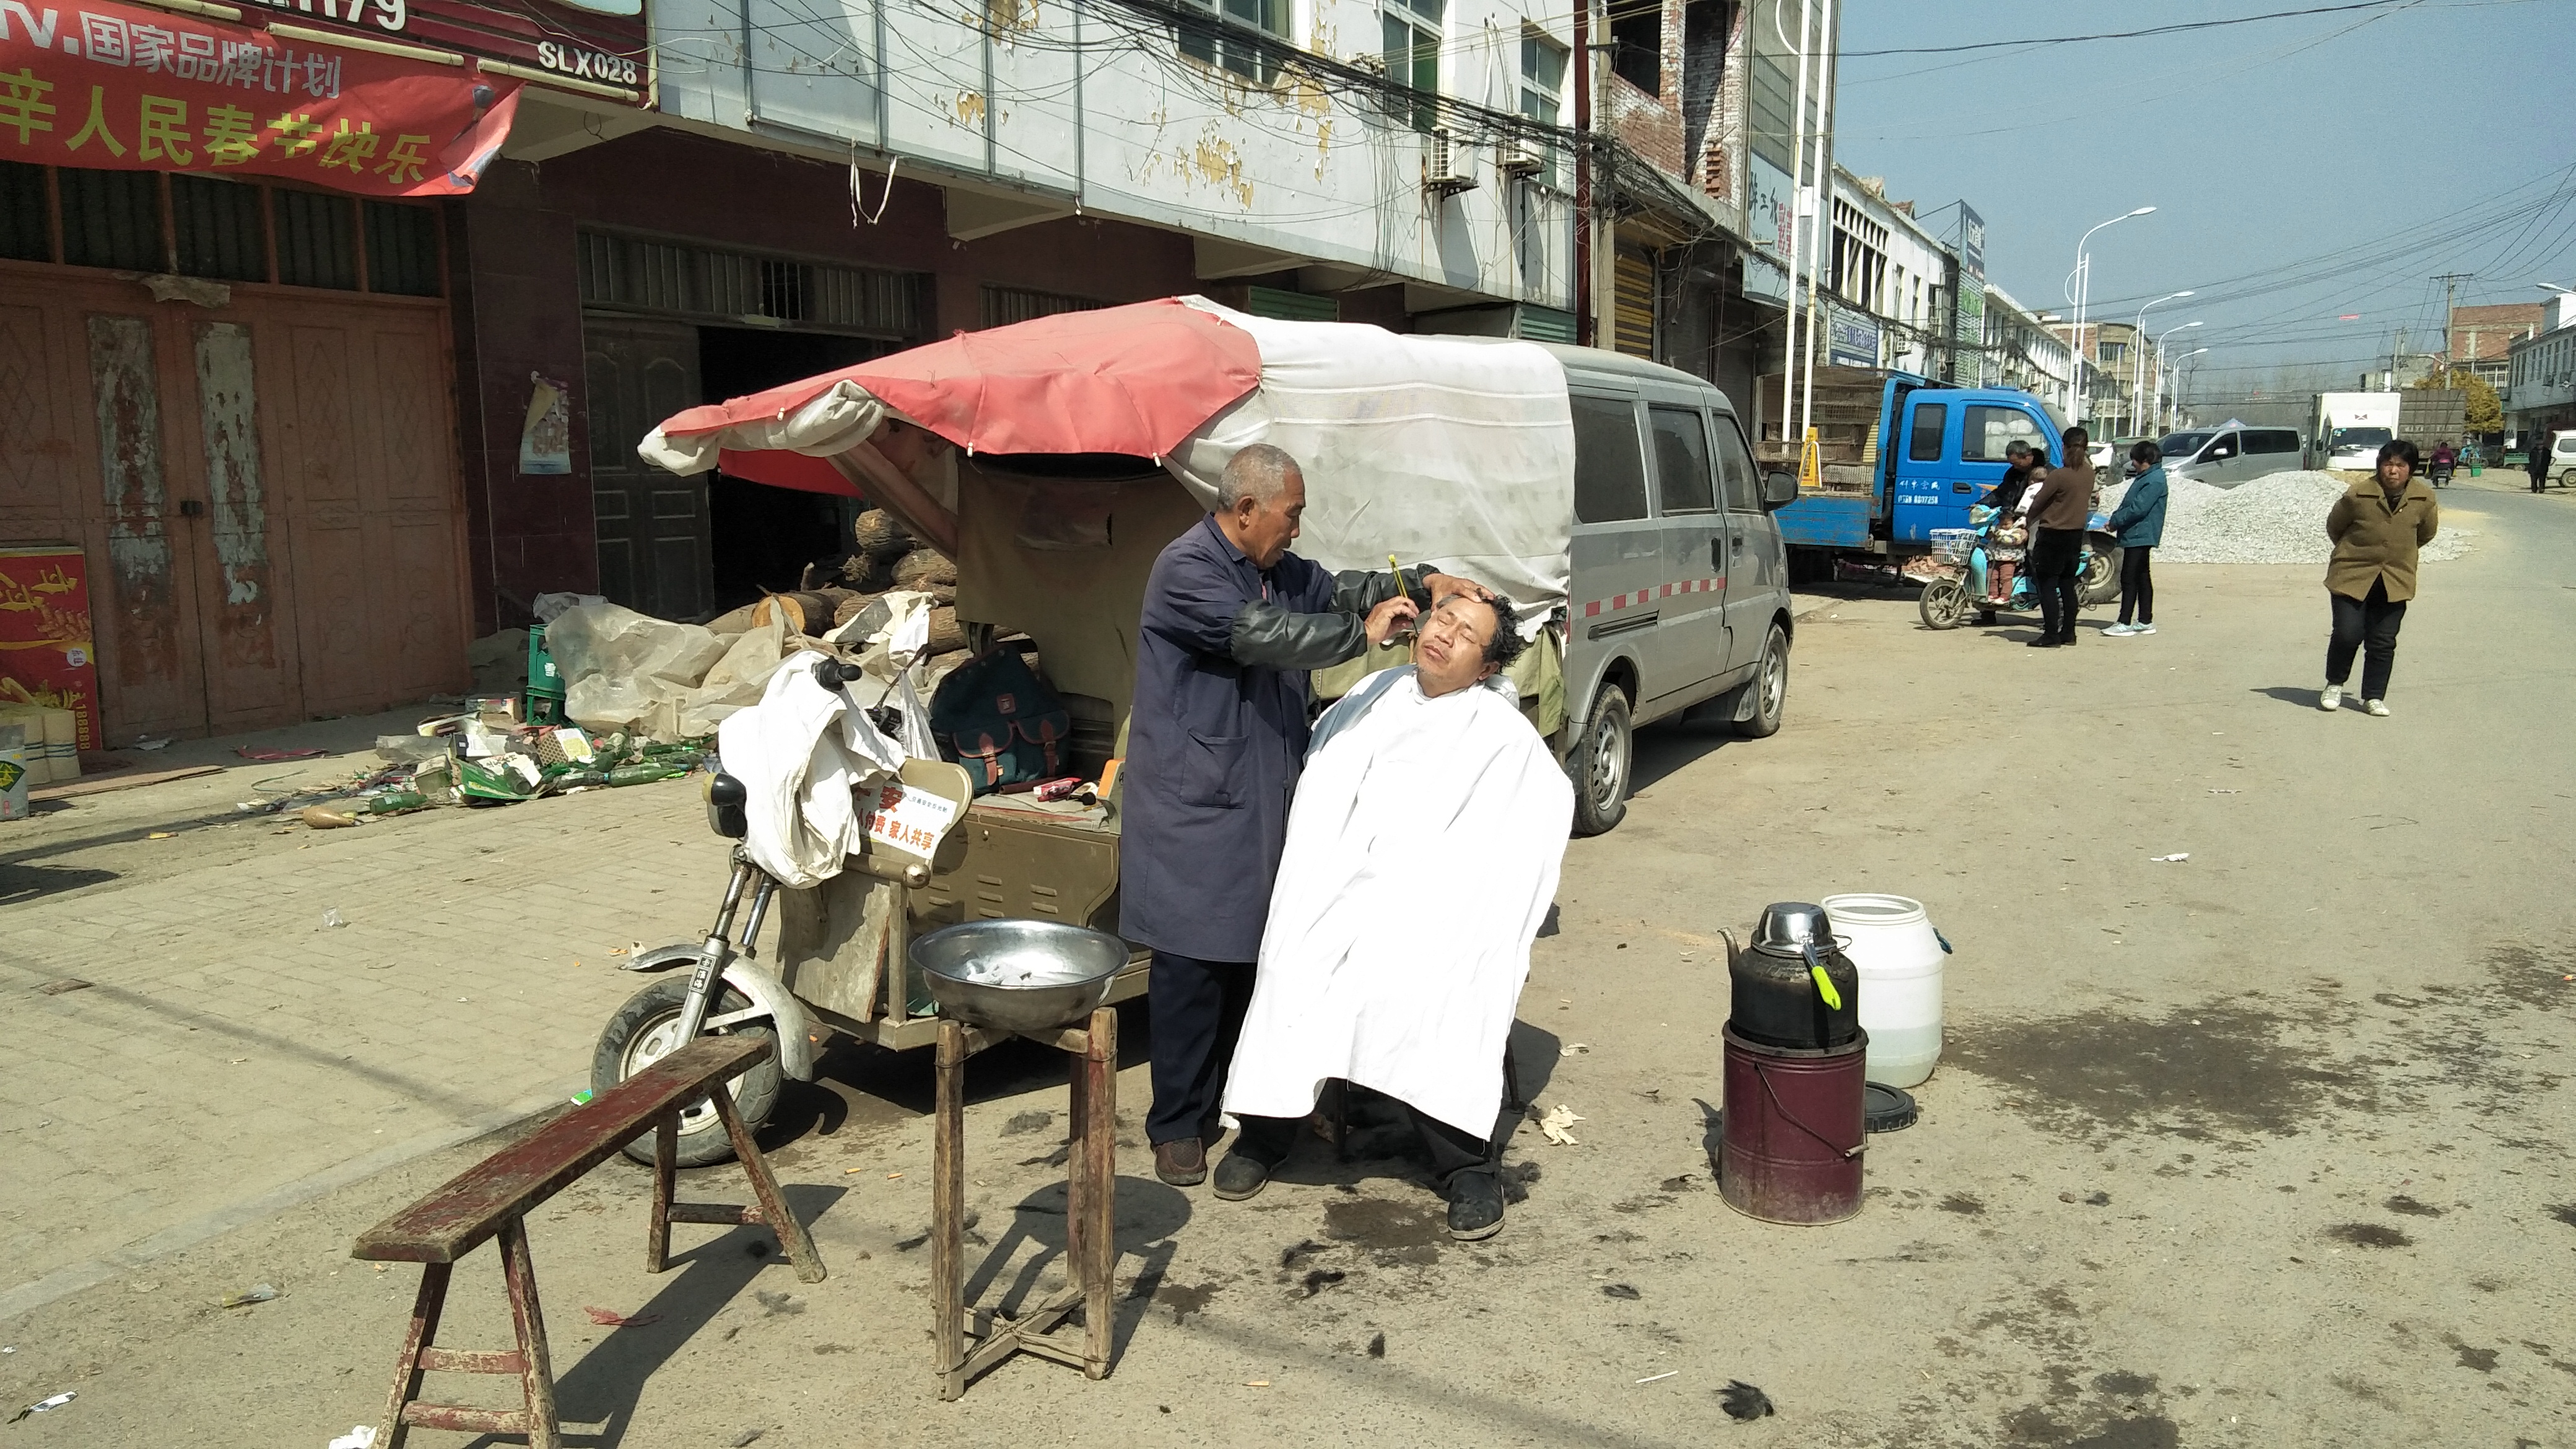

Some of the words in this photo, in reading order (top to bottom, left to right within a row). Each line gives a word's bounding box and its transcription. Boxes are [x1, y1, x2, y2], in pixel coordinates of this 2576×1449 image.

[537, 40, 637, 85] SLX028
[888, 820, 934, 851] 家人共享
